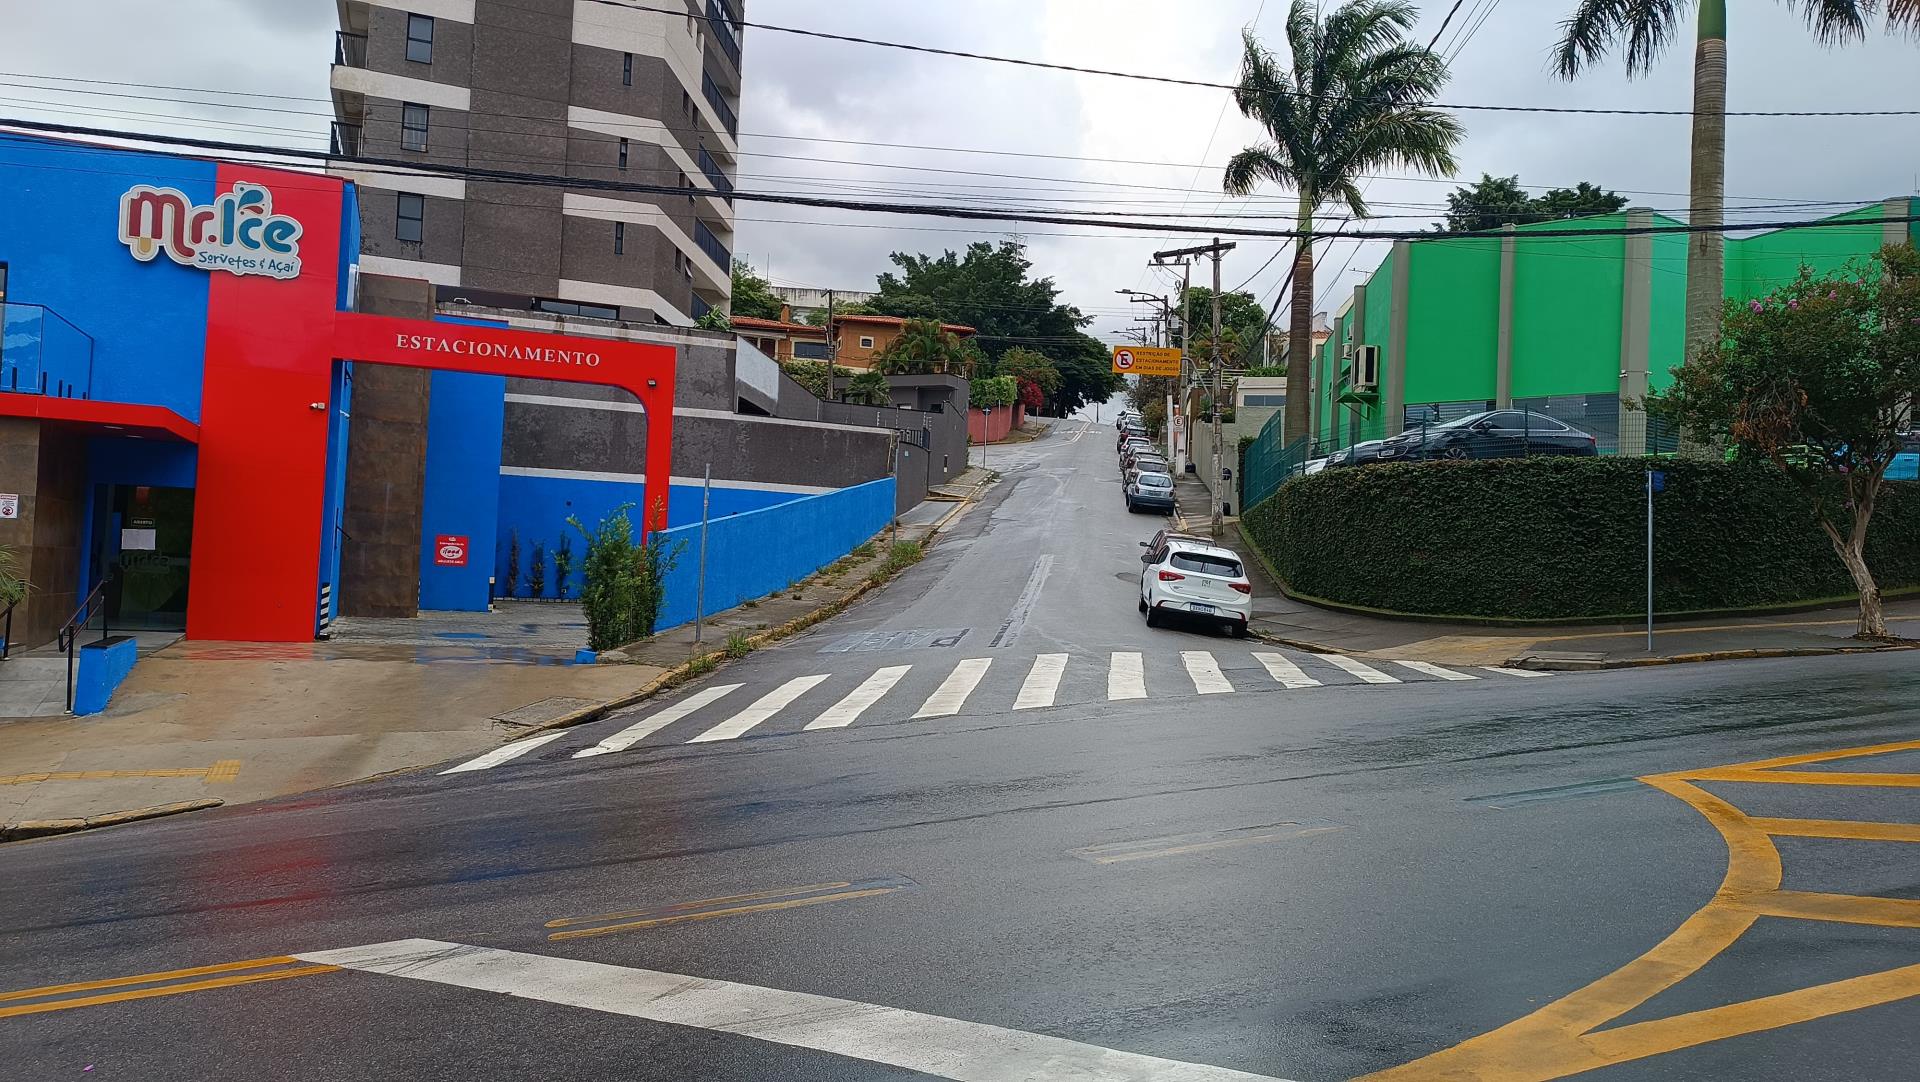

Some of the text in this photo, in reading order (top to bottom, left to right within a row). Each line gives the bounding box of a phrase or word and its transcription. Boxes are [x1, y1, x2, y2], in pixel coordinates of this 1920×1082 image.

[198, 251, 256, 269] Sorvetes
[267, 260, 296, 273] Açaí
[395, 333, 601, 367] ESTACIONAMENTO
